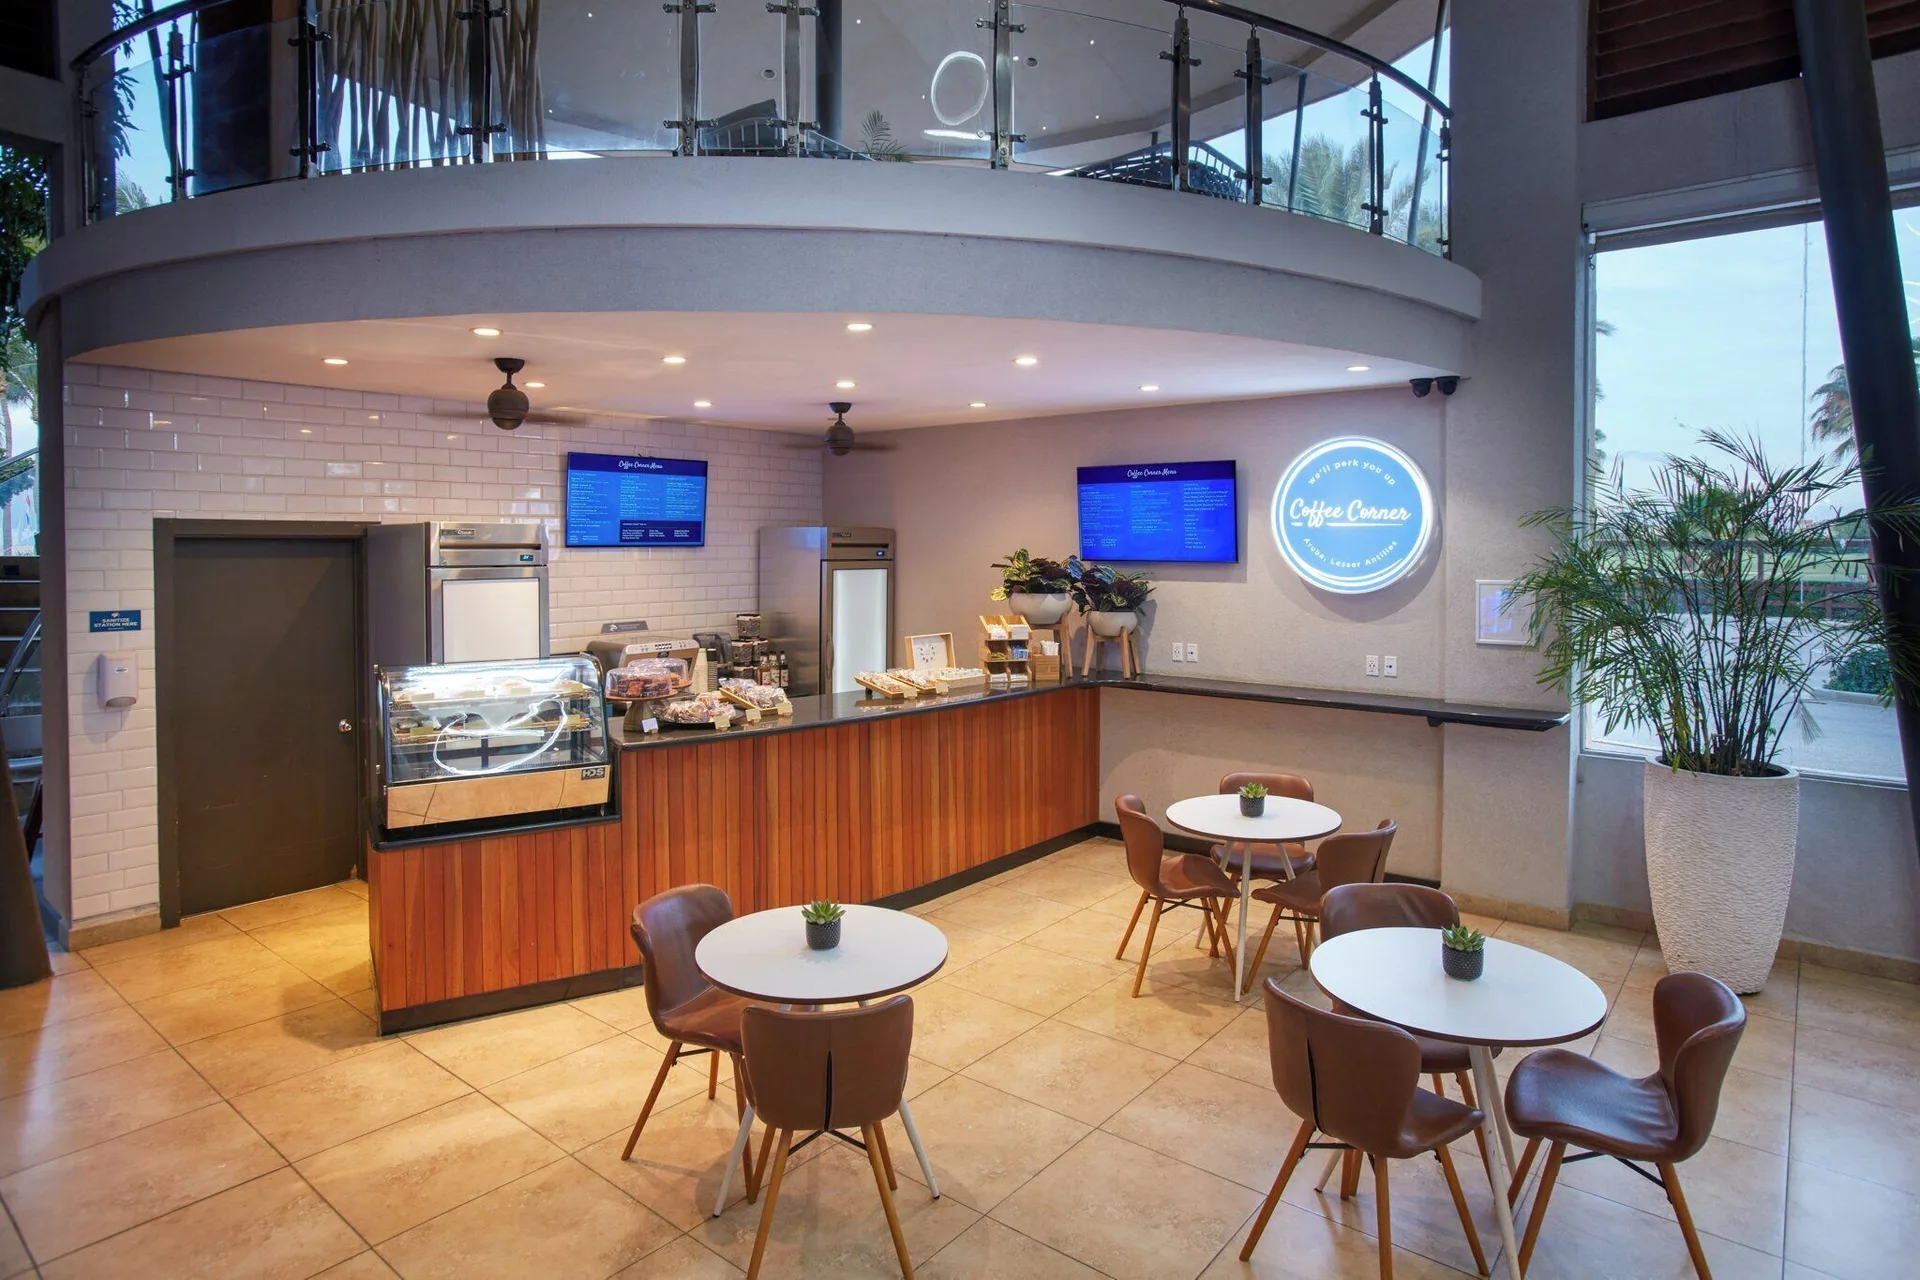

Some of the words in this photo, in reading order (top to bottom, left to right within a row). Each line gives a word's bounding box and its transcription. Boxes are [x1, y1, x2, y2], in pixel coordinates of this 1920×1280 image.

[618, 460, 634, 470] Coffee
[1127, 469, 1144, 479] Coffee
[1144, 468, 1162, 477] Corner
[1162, 468, 1178, 476] Menu
[1308, 465, 1331, 485] we'll
[1334, 459, 1359, 470] perk
[1362, 461, 1382, 474] you
[1383, 473, 1396, 487] up
[1289, 497, 1345, 528] Coffee
[1347, 499, 1412, 522] Corner
[1303, 537, 1327, 562] Aruba,
[1329, 557, 1361, 568] Lesser
[1364, 540, 1398, 566] Antilles
[582, 768, 604, 777] HDS
